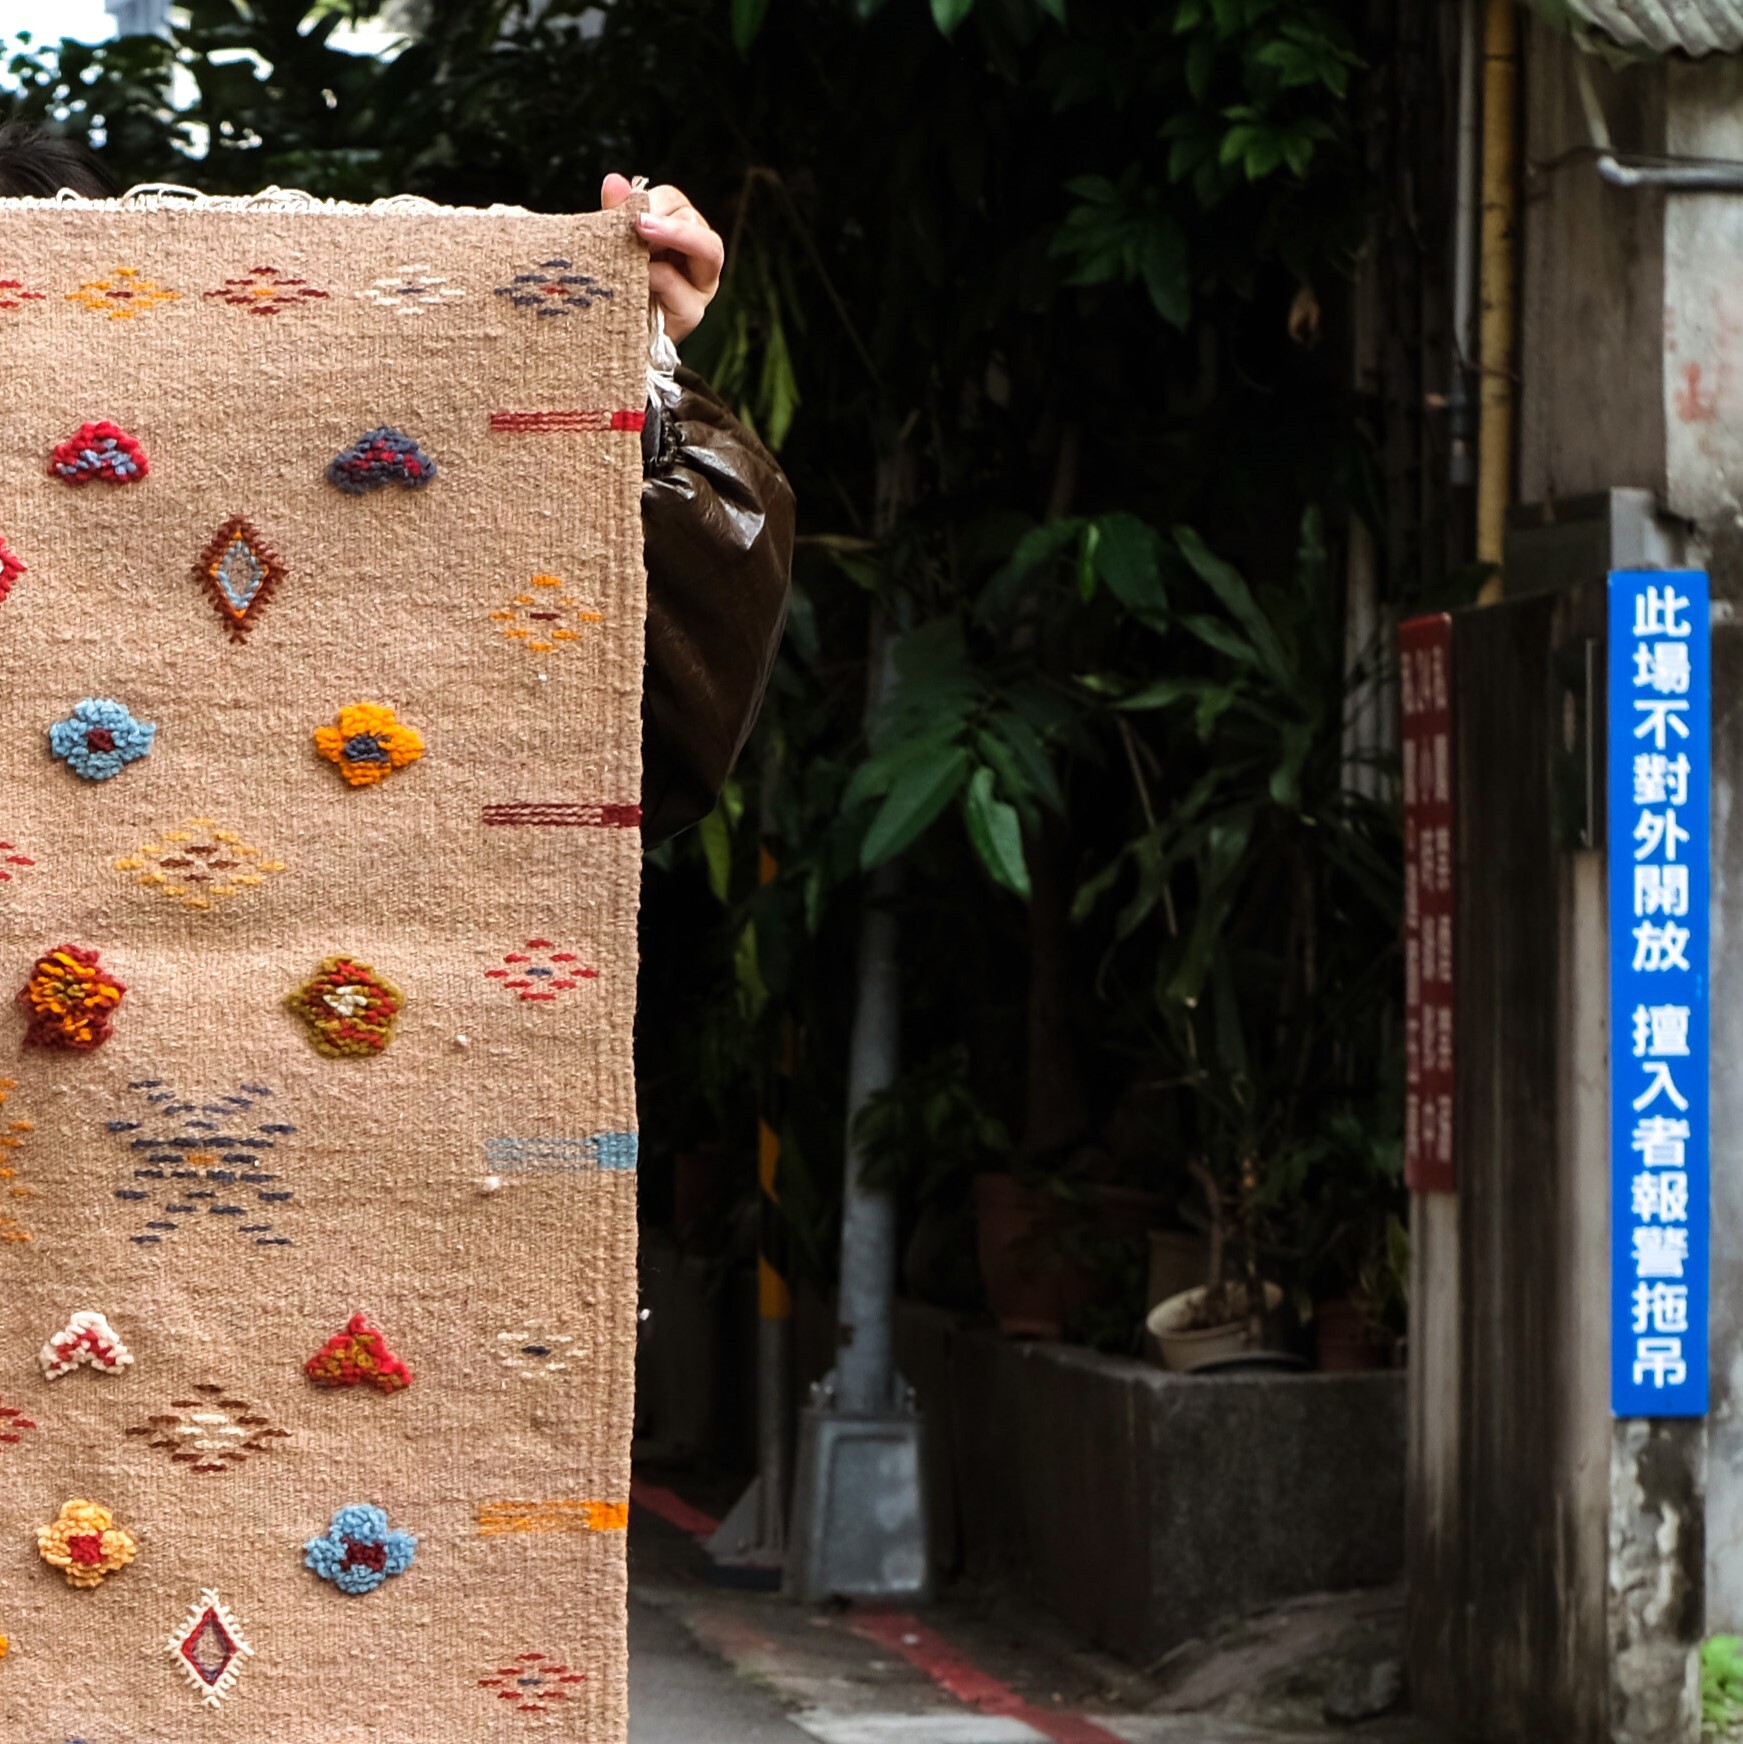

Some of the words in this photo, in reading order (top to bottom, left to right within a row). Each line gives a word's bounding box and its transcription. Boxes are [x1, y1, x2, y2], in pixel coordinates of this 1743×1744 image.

[1632, 585, 1691, 971] 此場不對外開放
[1631, 1004, 1691, 1388] 擅入者報警拖吊
